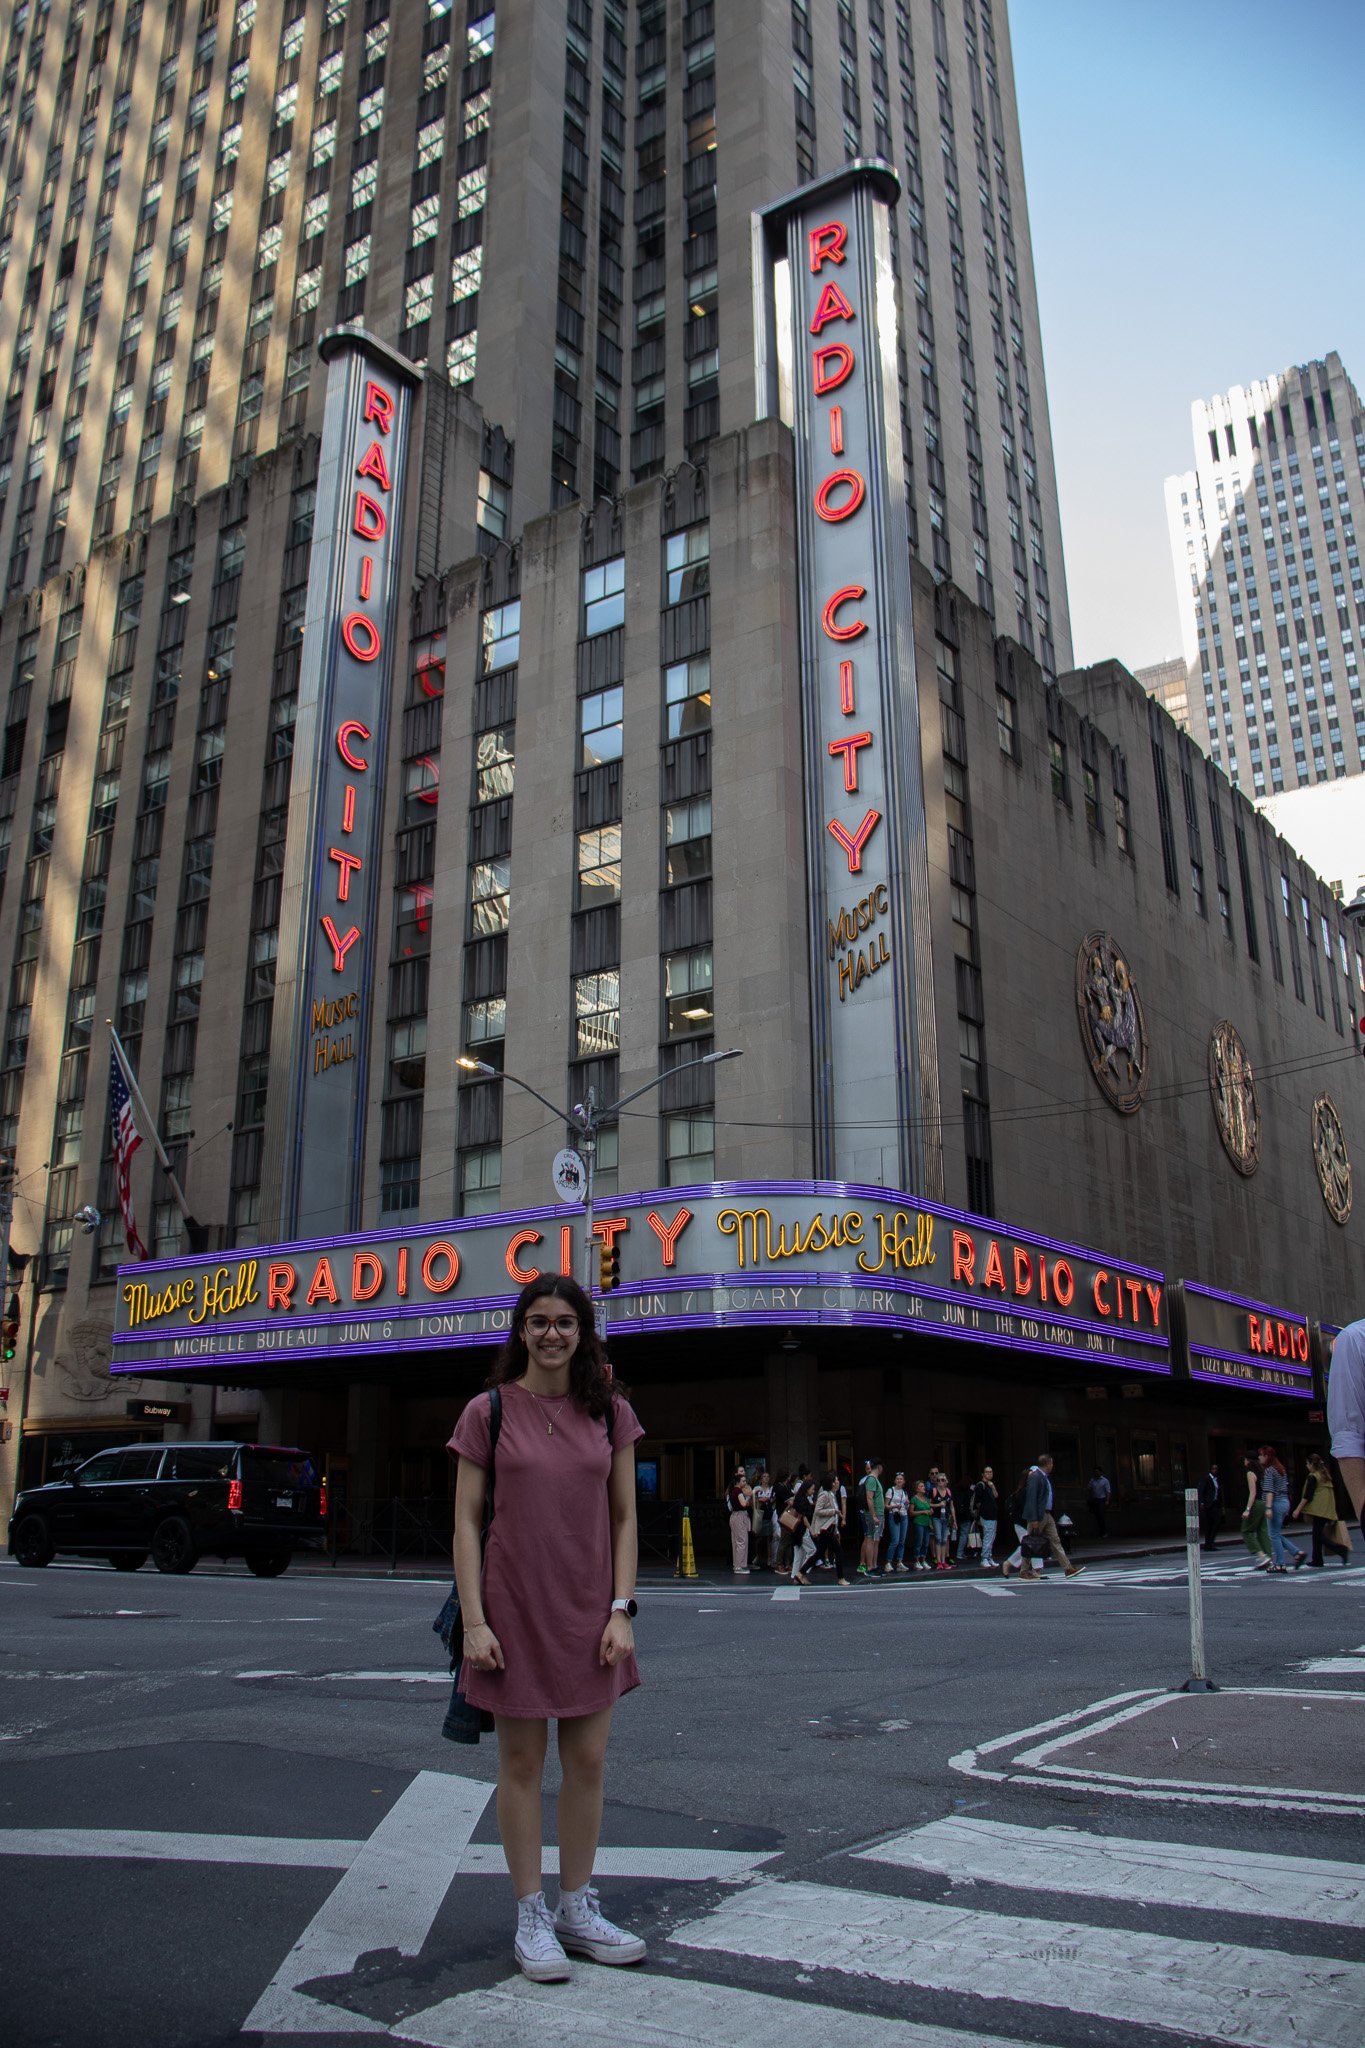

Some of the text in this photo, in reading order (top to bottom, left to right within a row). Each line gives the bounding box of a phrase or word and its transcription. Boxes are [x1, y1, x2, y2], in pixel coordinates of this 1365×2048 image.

[808, 220, 883, 873] RADIO CITY
[321, 379, 396, 973] RADIO CITY
[267, 1206, 695, 1311] RADIO CITY
[717, 1207, 938, 1273] Music Hall
[123, 1260, 260, 1327] Music Hall
[949, 1228, 1162, 1327] RADIO CITY
[173, 1333, 246, 1356] MICHELLE
[256, 1327, 318, 1349] BUTEAU
[339, 1323, 375, 1343] JUN
[382, 1321, 393, 1339] 6
[417, 1314, 466, 1336] TONY
[626, 1287, 1115, 1354] JUN 7 GARY CLARK JR. JUN 11 THE KID LAROI JUN 17
[1248, 1313, 1309, 1362] RADIO
[1201, 1355, 1220, 1373] LIZZY
[1223, 1361, 1254, 1380] MCALPINE
[1260, 1369, 1272, 1382] JUN
[143, 1404, 172, 1417] Subway
